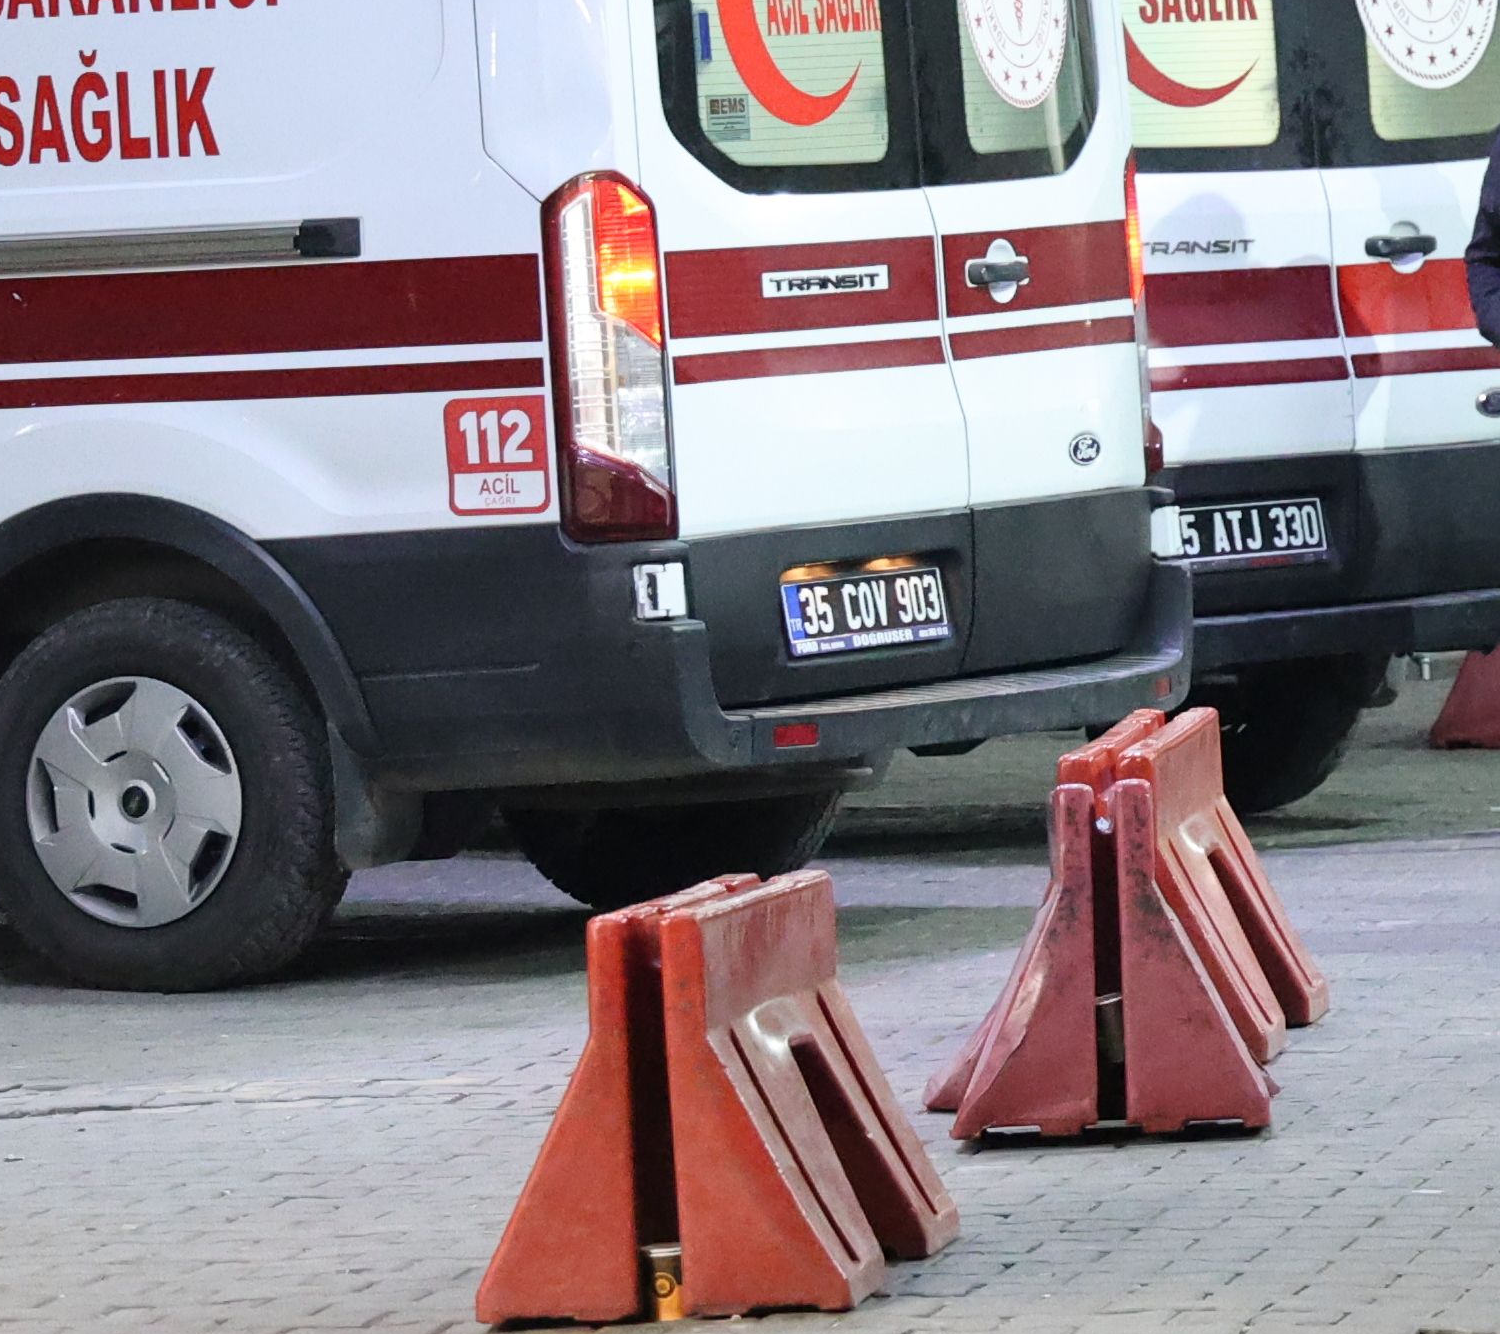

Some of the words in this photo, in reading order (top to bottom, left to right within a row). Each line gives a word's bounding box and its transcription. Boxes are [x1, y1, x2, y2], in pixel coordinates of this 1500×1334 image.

[769, 273, 880, 292] TRANSIT
[459, 409, 534, 464] 112
[479, 473, 521, 496] ACİL
[1213, 509, 1262, 553] ATJ
[1268, 505, 1320, 548] 330
[799, 586, 835, 635] 35
[841, 579, 888, 630] COV
[895, 574, 941, 623] 903
